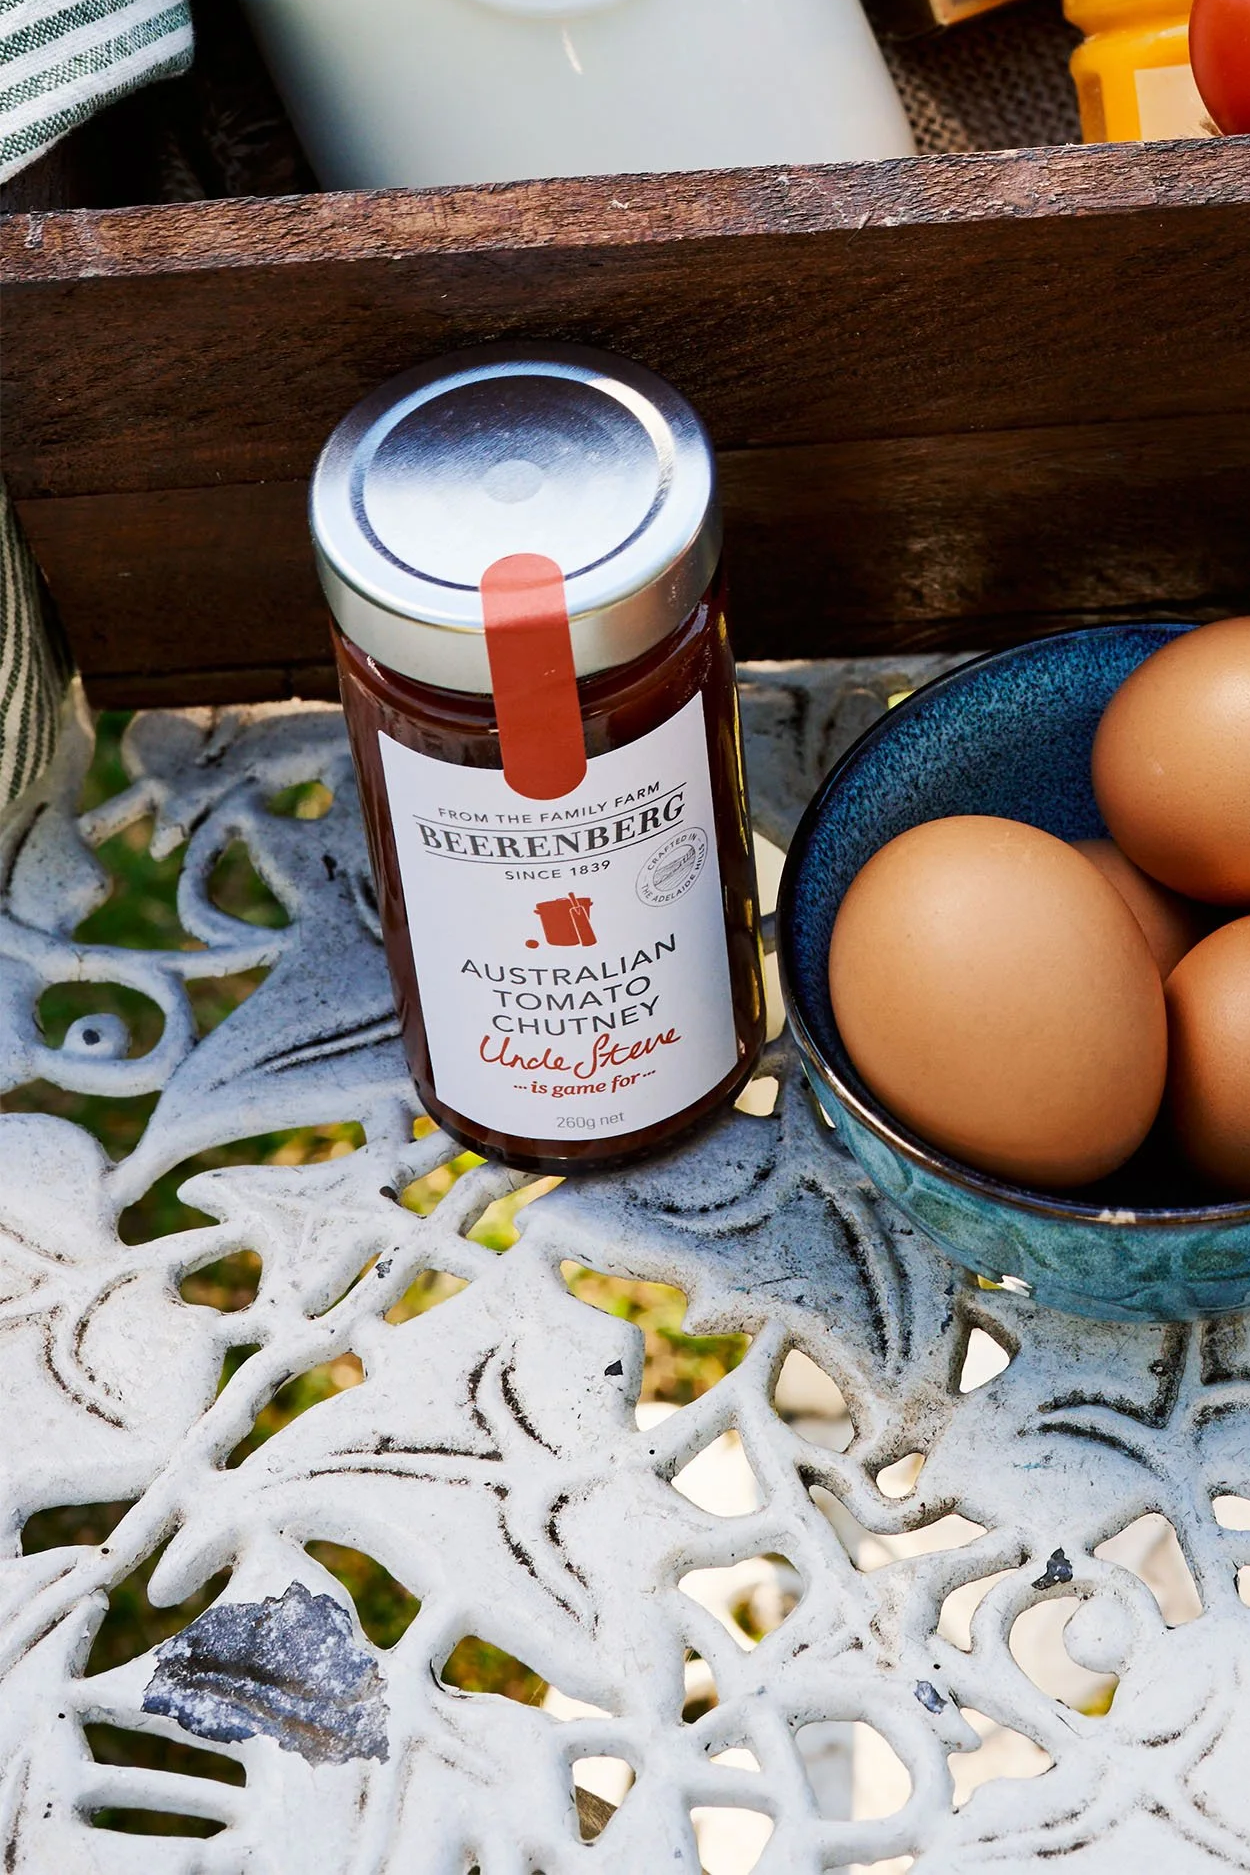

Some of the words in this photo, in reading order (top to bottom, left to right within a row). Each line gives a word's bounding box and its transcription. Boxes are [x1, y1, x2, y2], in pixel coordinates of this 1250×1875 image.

[439, 808, 488, 823] FROM
[496, 814, 531, 823] THE
[541, 801, 608, 822] FAMILY
[615, 781, 660, 807] FARM
[419, 792, 685, 858] BEERENBERG
[505, 869, 561, 880] SINCE
[570, 860, 610, 875] 1839
[641, 884, 653, 898] THE
[652, 874, 696, 902] ADELAIDE
[695, 843, 704, 870] HILLS
[647, 834, 687, 871] CRAFTED
[688, 833, 697, 841] IN
[461, 933, 676, 986] AUSTRALIAN
[492, 976, 651, 1011] TOMATO
[492, 995, 660, 1036] CHUTNEY
[480, 1035, 571, 1070] Uncle
[573, 1028, 682, 1079] Steve
[551, 1081, 607, 1099] game
[556, 1116, 596, 1130] 260g
[600, 1111, 625, 1126] net
